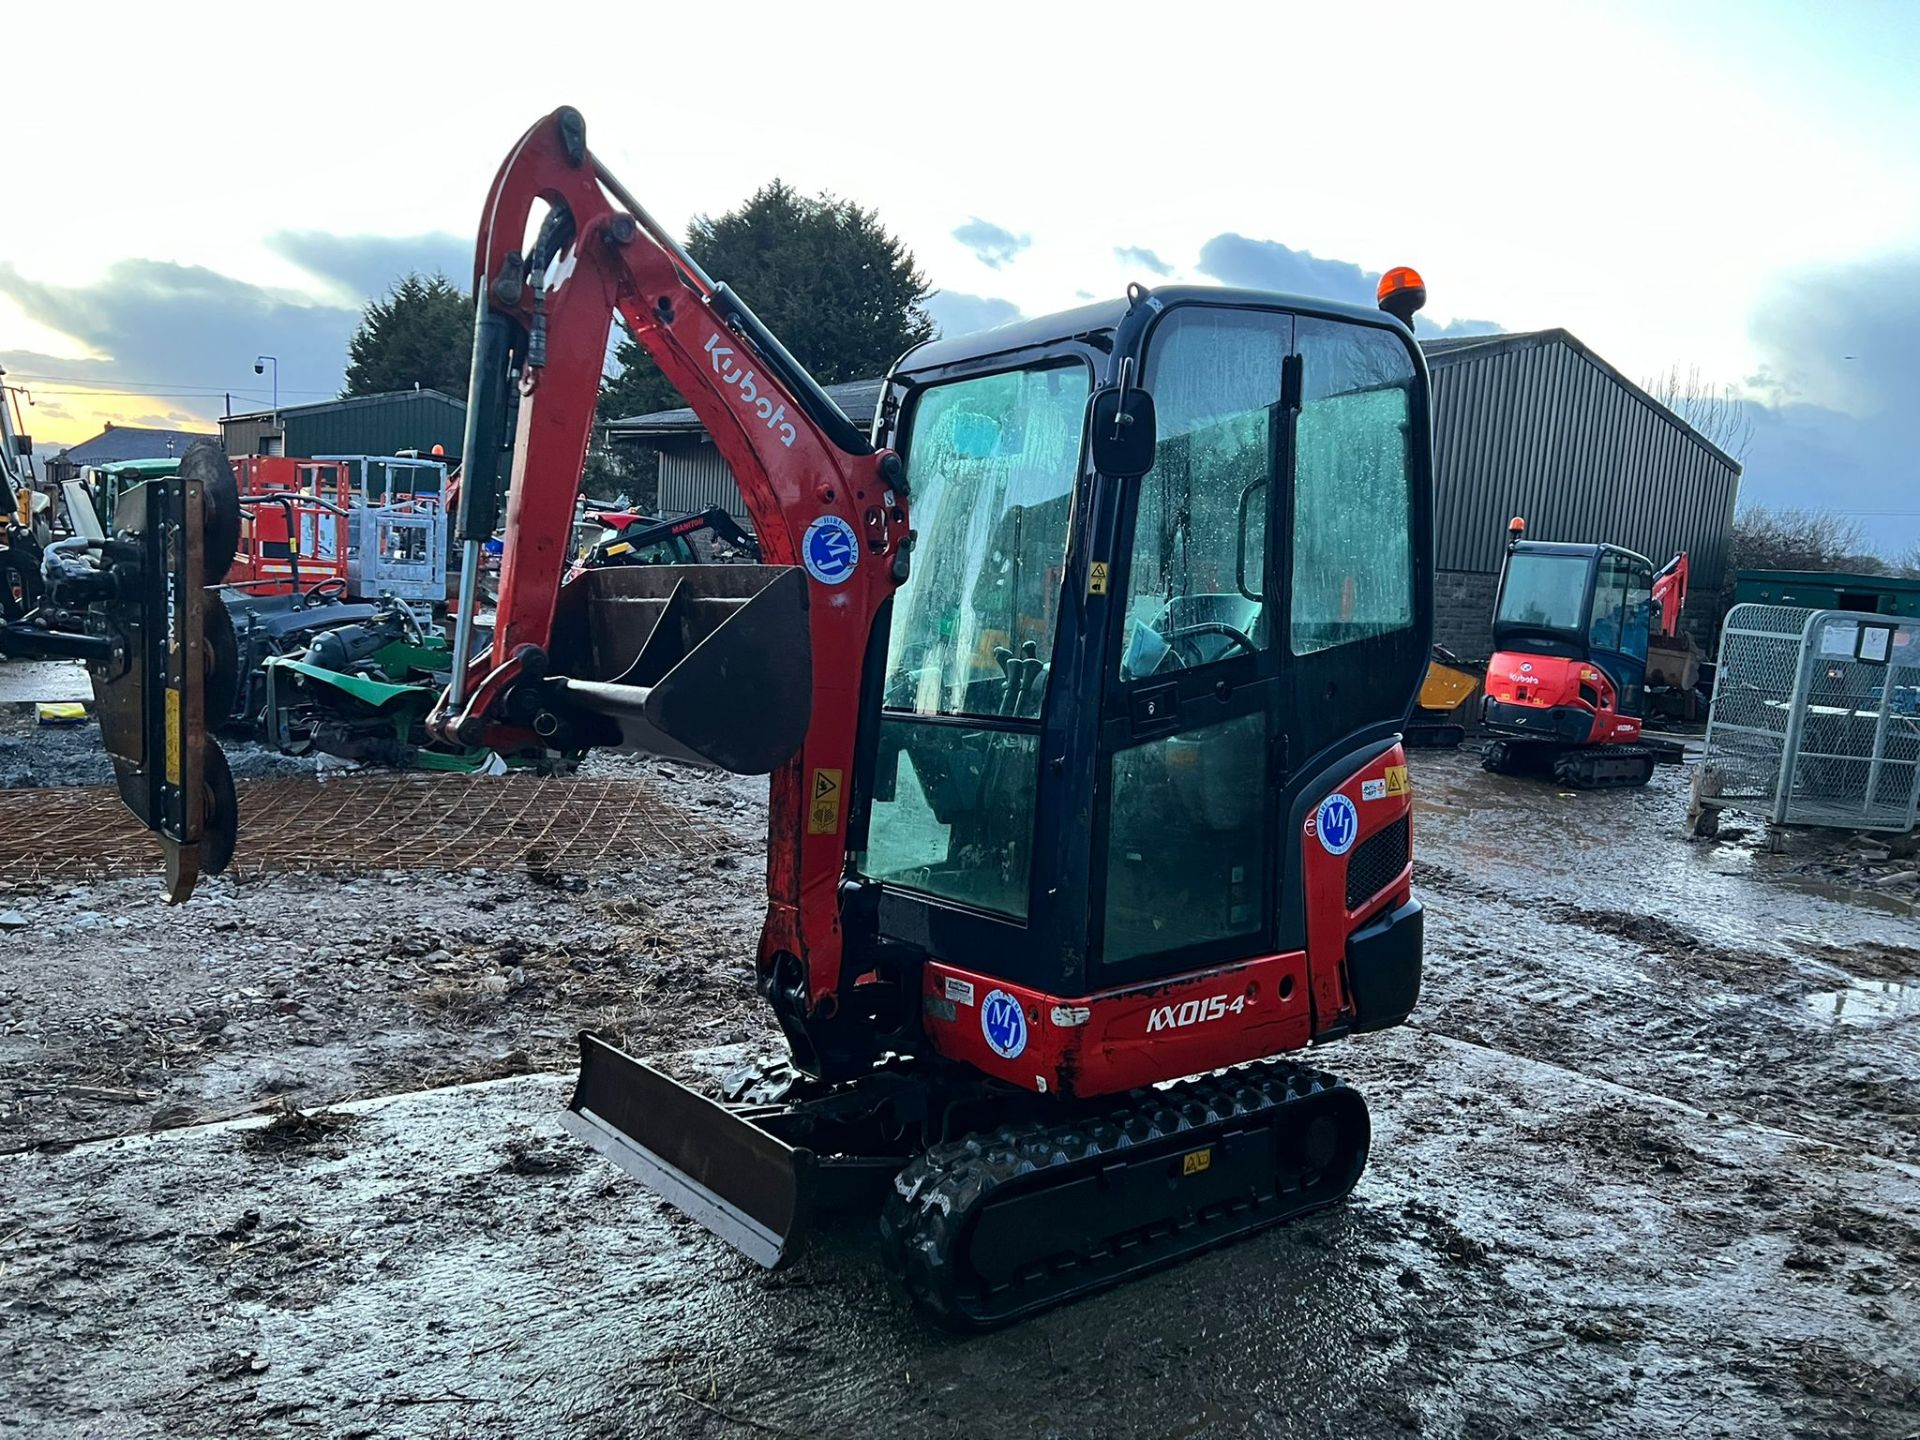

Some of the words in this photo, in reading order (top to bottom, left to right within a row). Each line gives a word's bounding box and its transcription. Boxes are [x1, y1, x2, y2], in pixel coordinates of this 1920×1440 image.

[704, 333, 796, 447] Kubota
[671, 517, 704, 535] MANITOU
[167, 572, 175, 638] MULTI
[1509, 673, 1539, 685] Kubota
[1318, 802, 1328, 820] HIRE
[1146, 994, 1245, 1033] KX015-4
